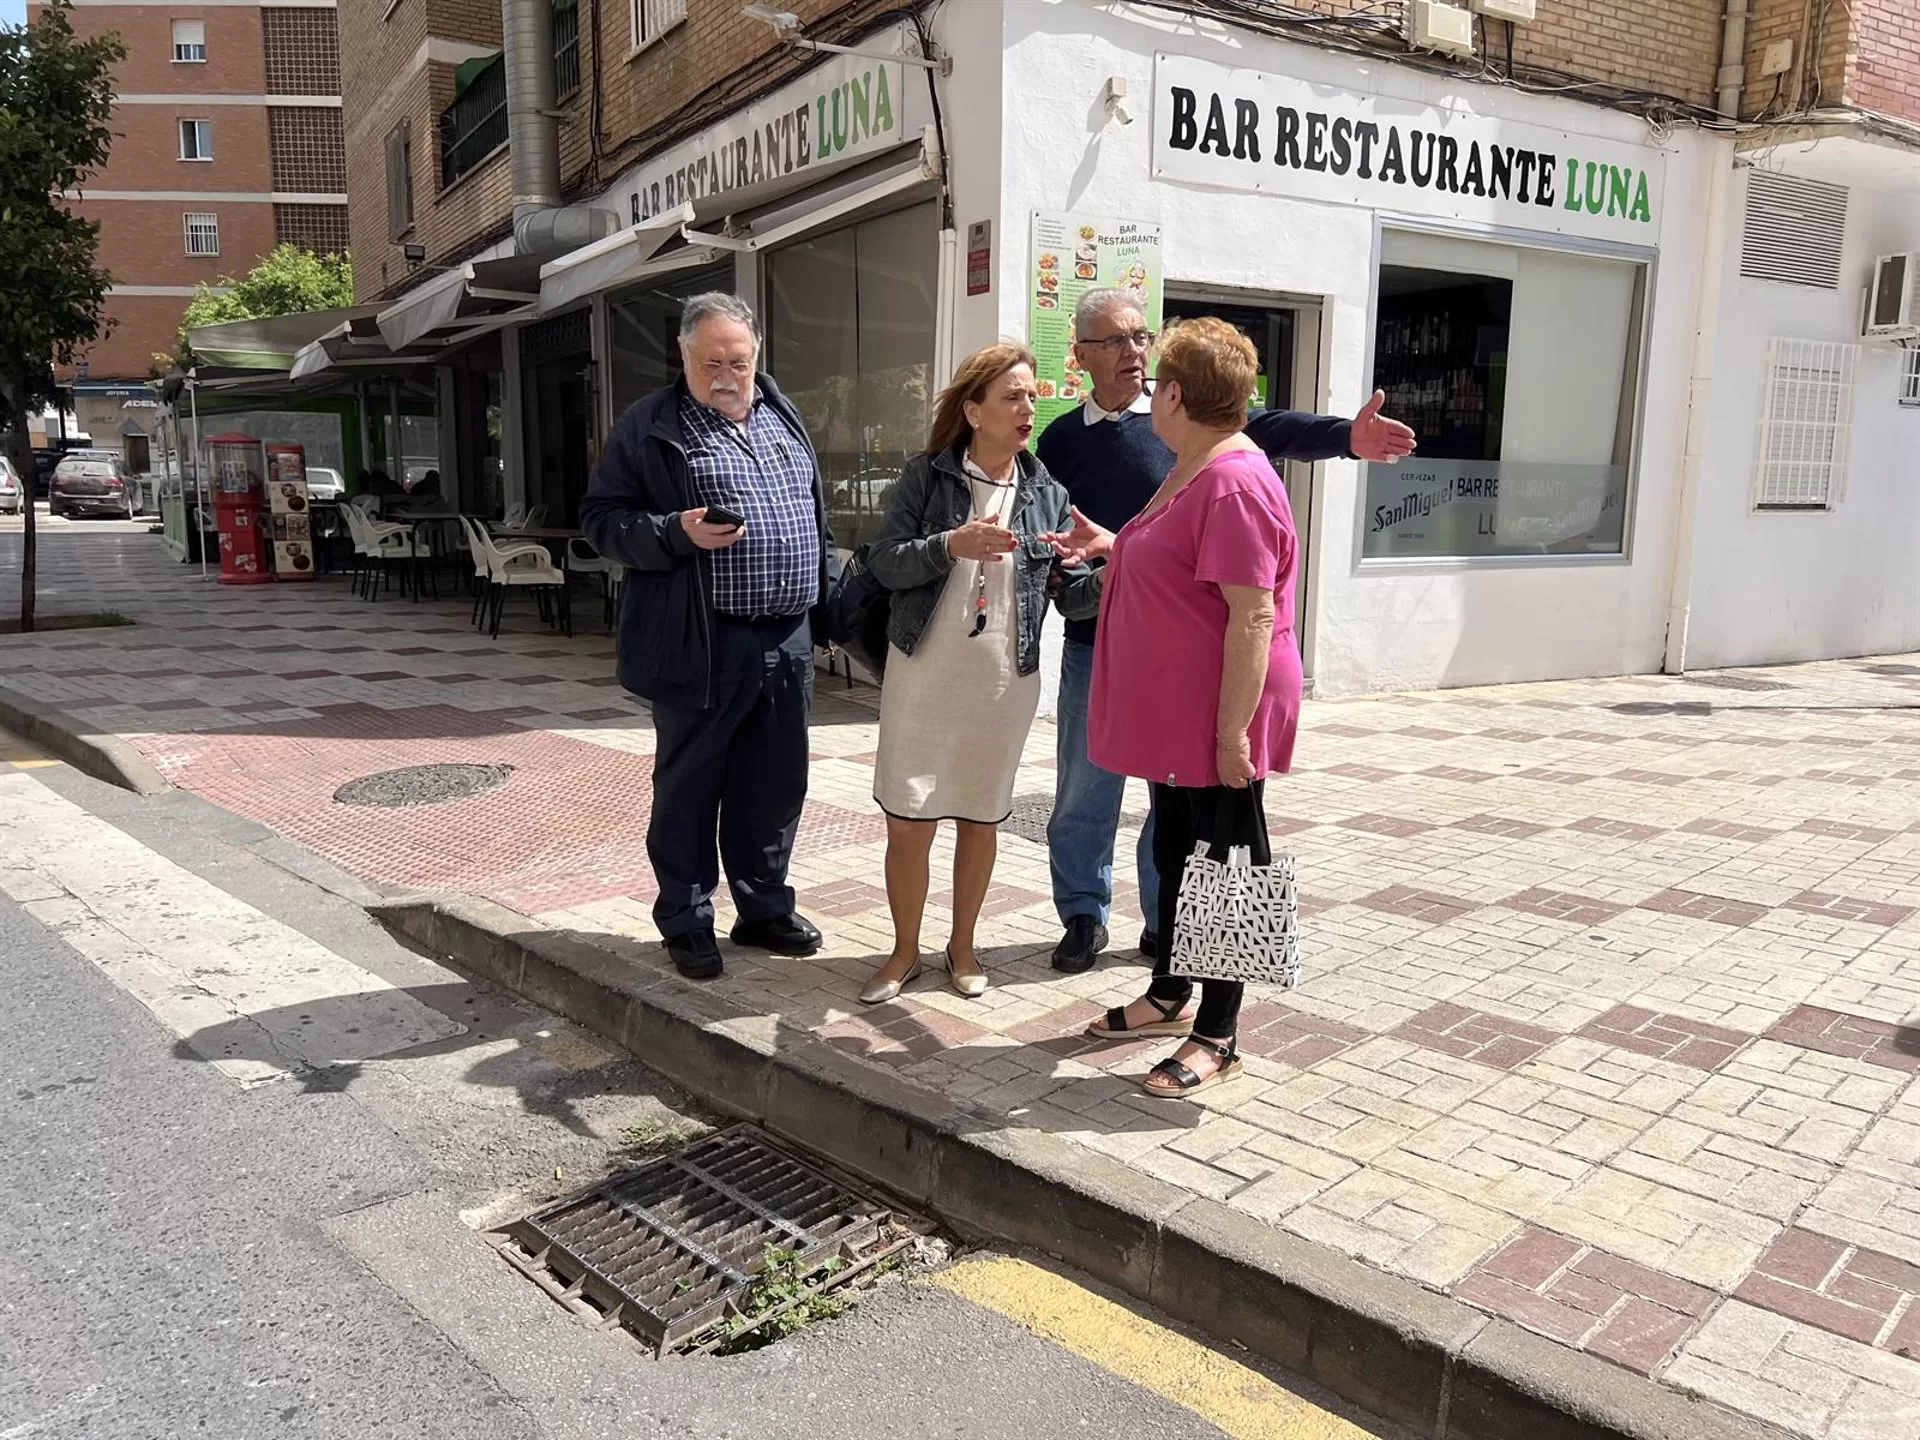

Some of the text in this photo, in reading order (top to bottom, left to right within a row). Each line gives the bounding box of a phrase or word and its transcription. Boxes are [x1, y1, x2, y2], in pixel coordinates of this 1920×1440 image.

[630, 64, 894, 226] BAR RESTAURANTE LUNA
[1169, 86, 1652, 223] BAR RESTAURANTE LUNA
[1119, 224, 1137, 235] BAR
[1097, 234, 1160, 246] RESTAURANTE
[1116, 246, 1140, 257] LUNA
[1400, 473, 1436, 482] CERVEZAS
[1457, 477, 1569, 501] BAR RESTURANTE
